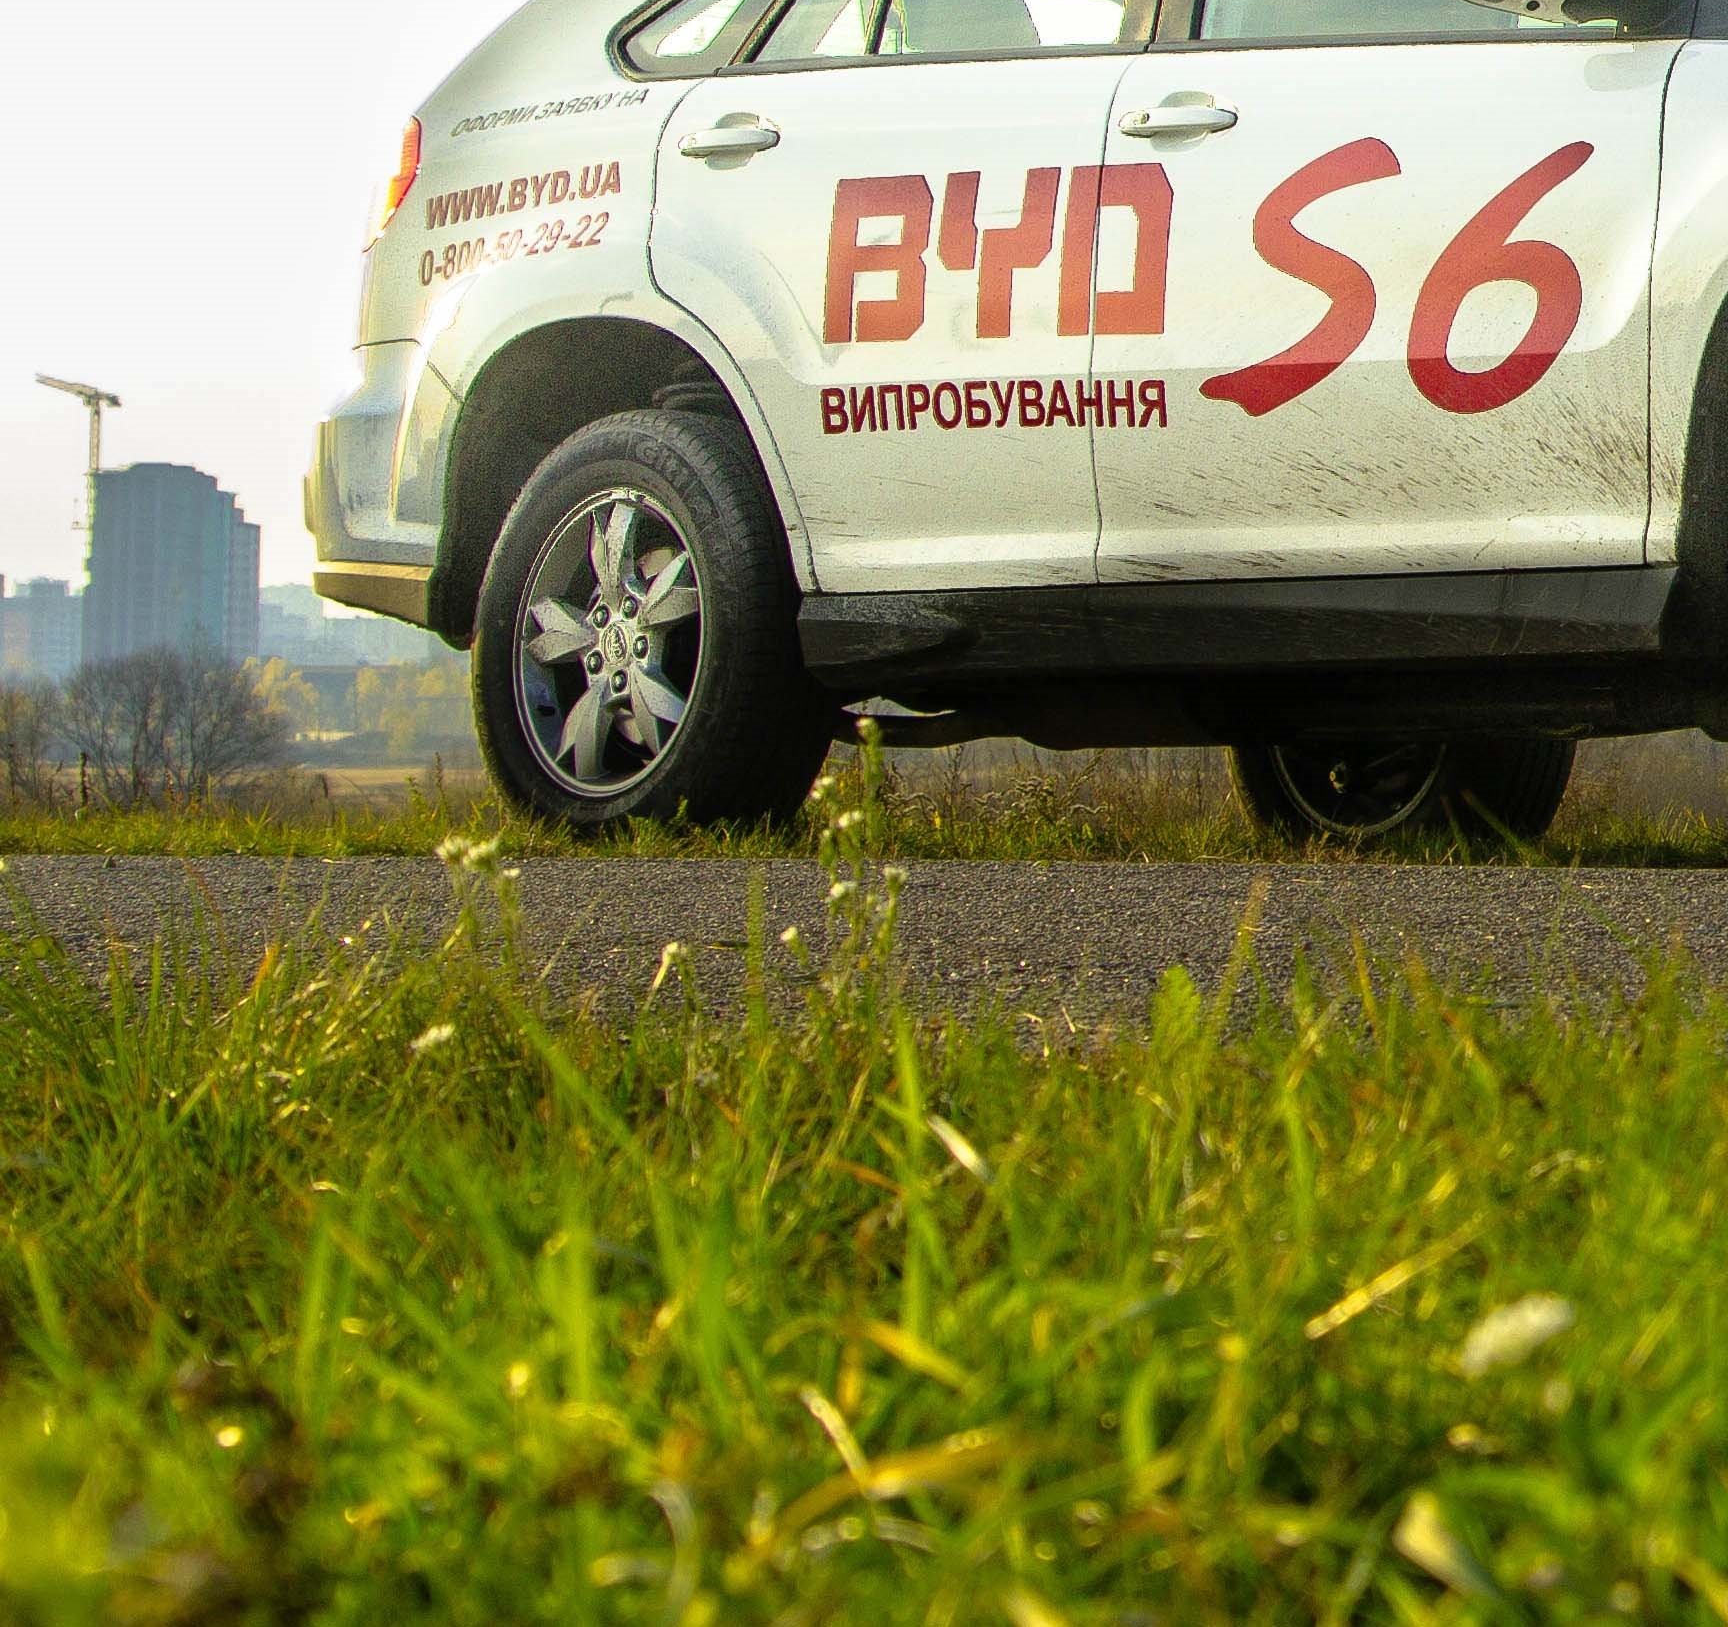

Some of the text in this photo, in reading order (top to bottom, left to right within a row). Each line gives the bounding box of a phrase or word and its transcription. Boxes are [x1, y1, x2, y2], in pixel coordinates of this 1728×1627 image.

[451, 88, 651, 137] ОФОРМИ ЗАЯВКУ НА
[425, 161, 622, 230] WWW.BYD.UA
[823, 136, 1594, 417] BYD S6
[820, 378, 1168, 434] ВИПРОБУВАННЯ
